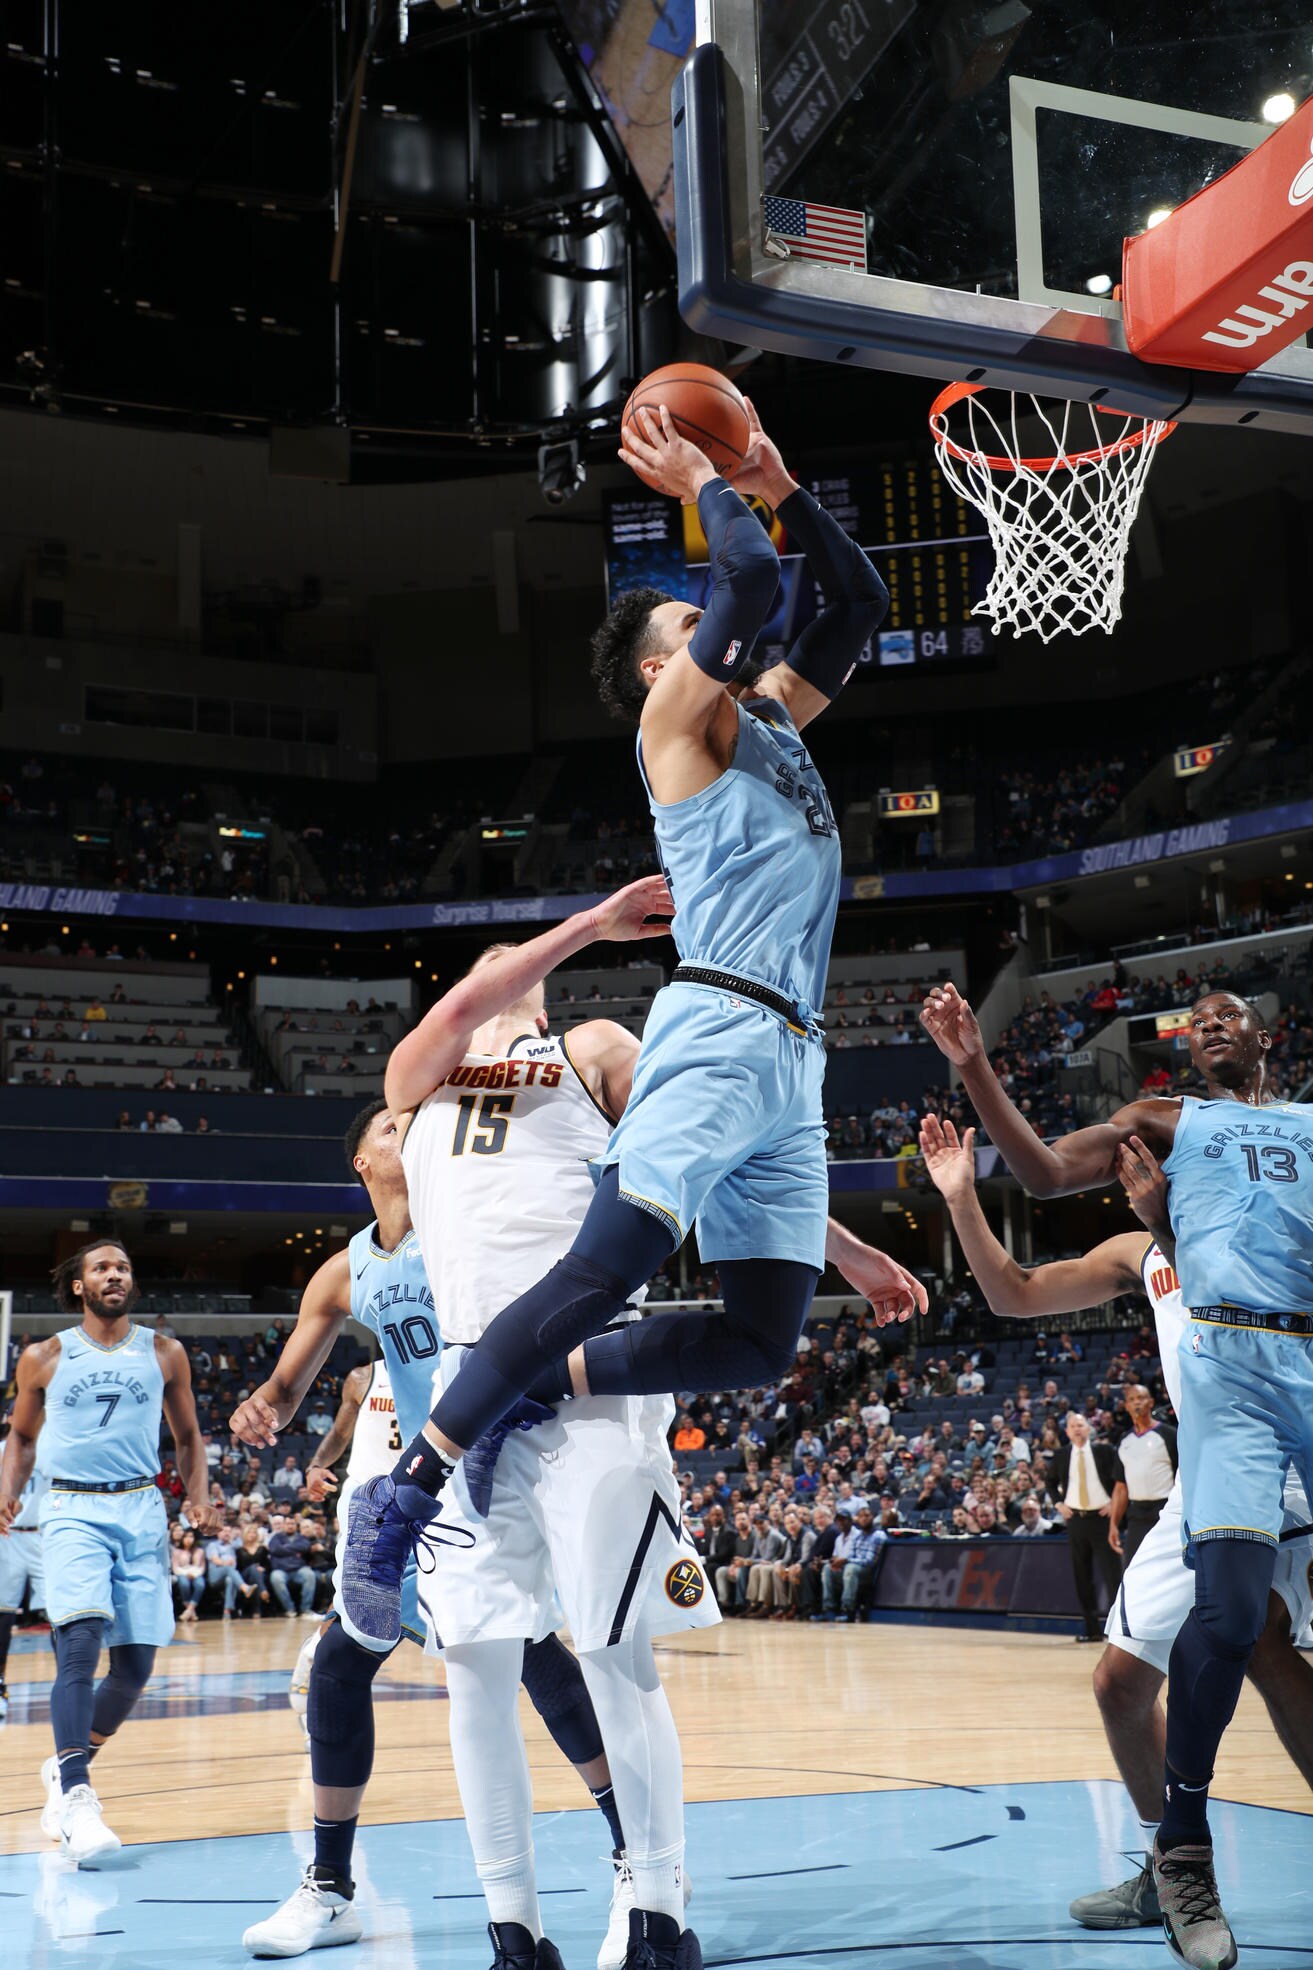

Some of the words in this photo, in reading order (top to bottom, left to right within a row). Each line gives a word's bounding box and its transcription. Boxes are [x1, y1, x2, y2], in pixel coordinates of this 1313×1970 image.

[920, 630, 948, 657] 64
[1078, 833, 1164, 876] SOUTHLAND
[1165, 818, 1230, 857] GAMING
[50, 887, 120, 916] GAMING
[433, 903, 490, 926] Surprise
[491, 899, 544, 921] Yourself
[434, 1060, 565, 1092] UGGETS
[451, 1093, 516, 1157] 15
[1240, 1144, 1299, 1183] 13
[383, 1315, 438, 1365] 10
[63, 1370, 150, 1408] GRIZZLIES
[95, 1394, 122, 1427] 7
[905, 1550, 1006, 1608] FedEx
